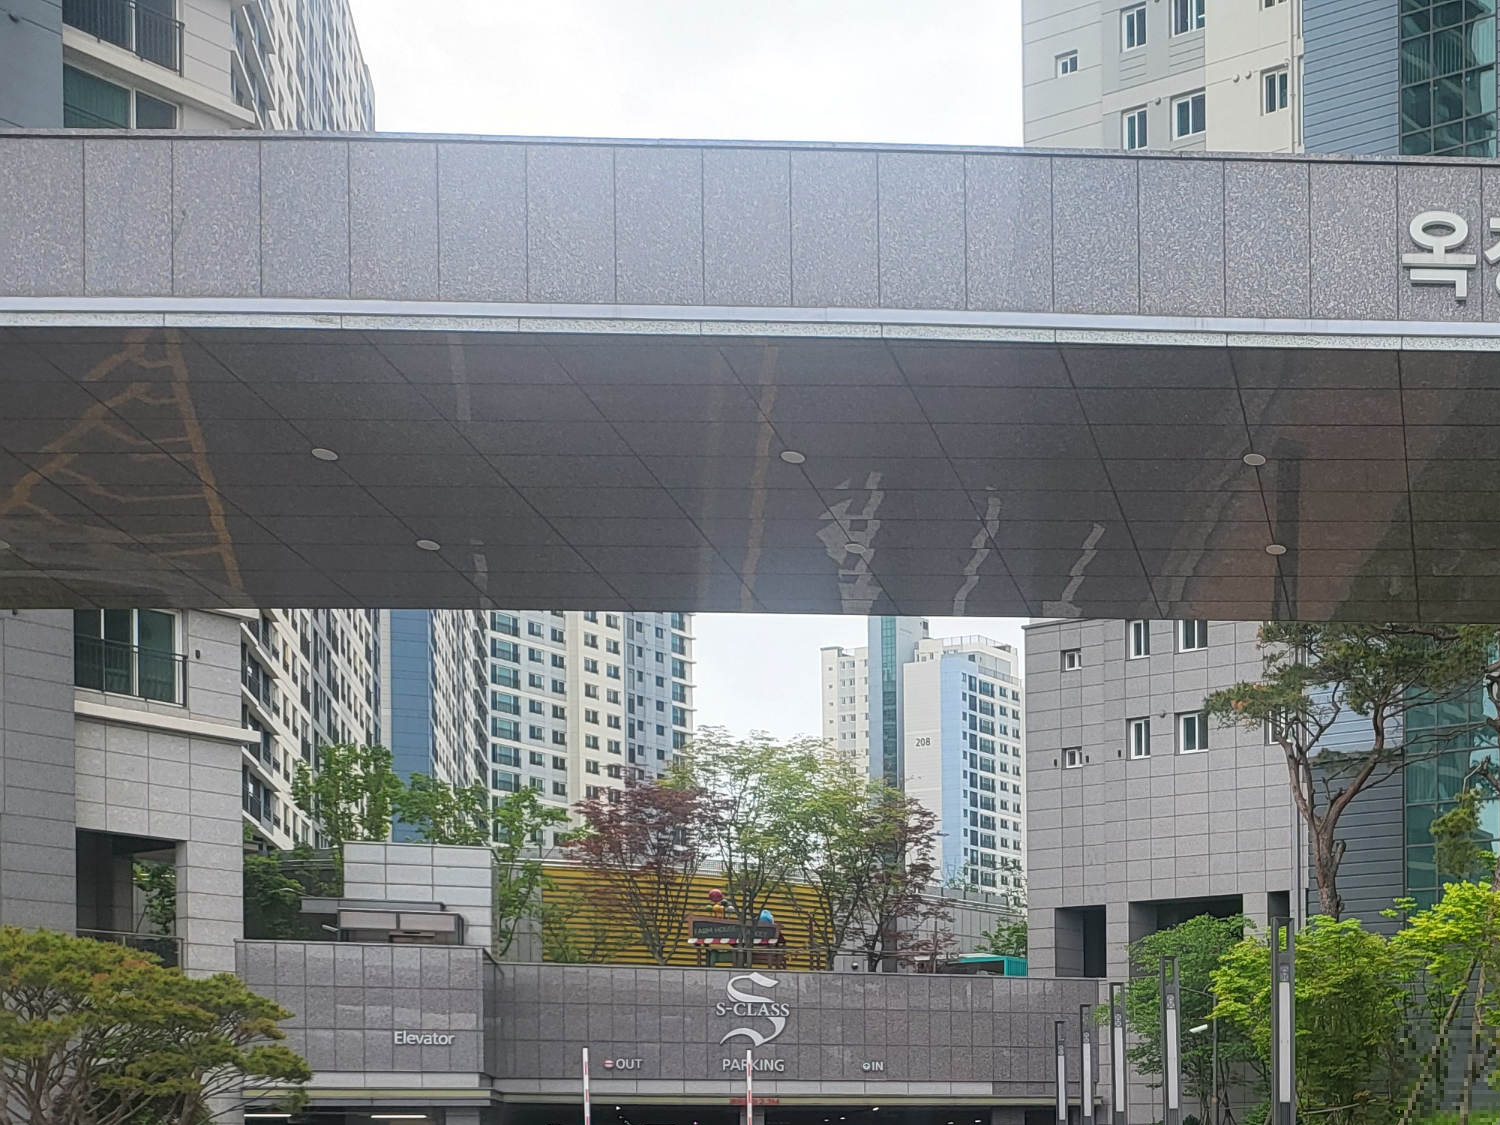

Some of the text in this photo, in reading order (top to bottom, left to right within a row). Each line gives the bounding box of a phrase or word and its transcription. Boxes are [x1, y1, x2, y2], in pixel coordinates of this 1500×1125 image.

[915, 737, 931, 747] 208
[716, 1002, 790, 1017] S-CLASS
[394, 1030, 456, 1045] Elevator
[616, 1058, 643, 1070] OUT
[871, 1061, 884, 1071] IN
